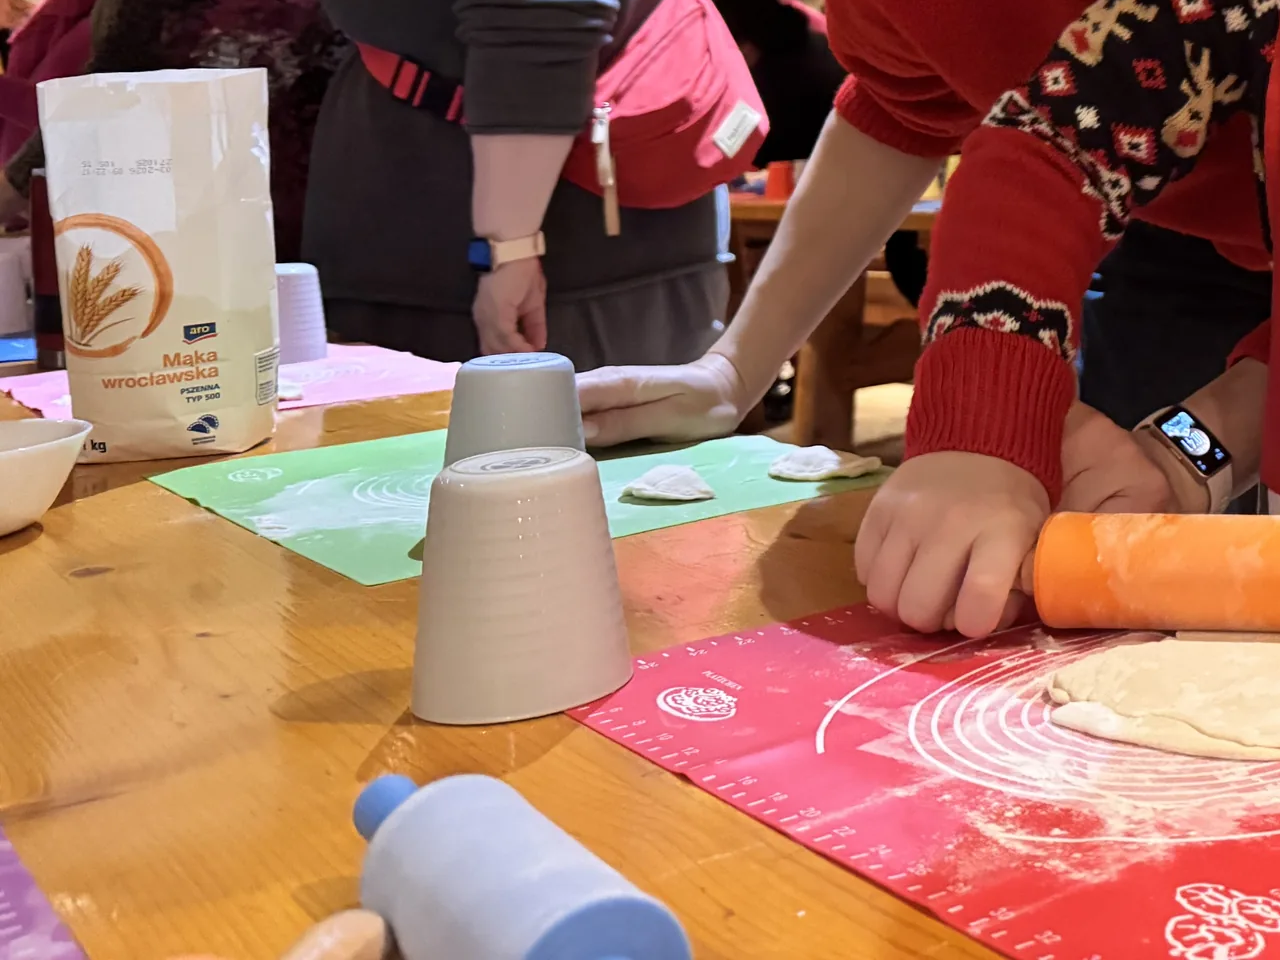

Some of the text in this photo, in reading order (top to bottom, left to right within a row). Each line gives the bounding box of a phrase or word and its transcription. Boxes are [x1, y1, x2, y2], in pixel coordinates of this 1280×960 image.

[190, 325, 210, 335] aro
[162, 350, 218, 368] Mąka
[101, 366, 219, 389] wrocławska
[180, 383, 220, 395] PSZENNA
[185, 392, 221, 403] TYP 500
[90, 439, 107, 453] kg
[738, 775, 758, 786] 16
[799, 807, 822, 818] 20
[832, 826, 857, 838] 22
